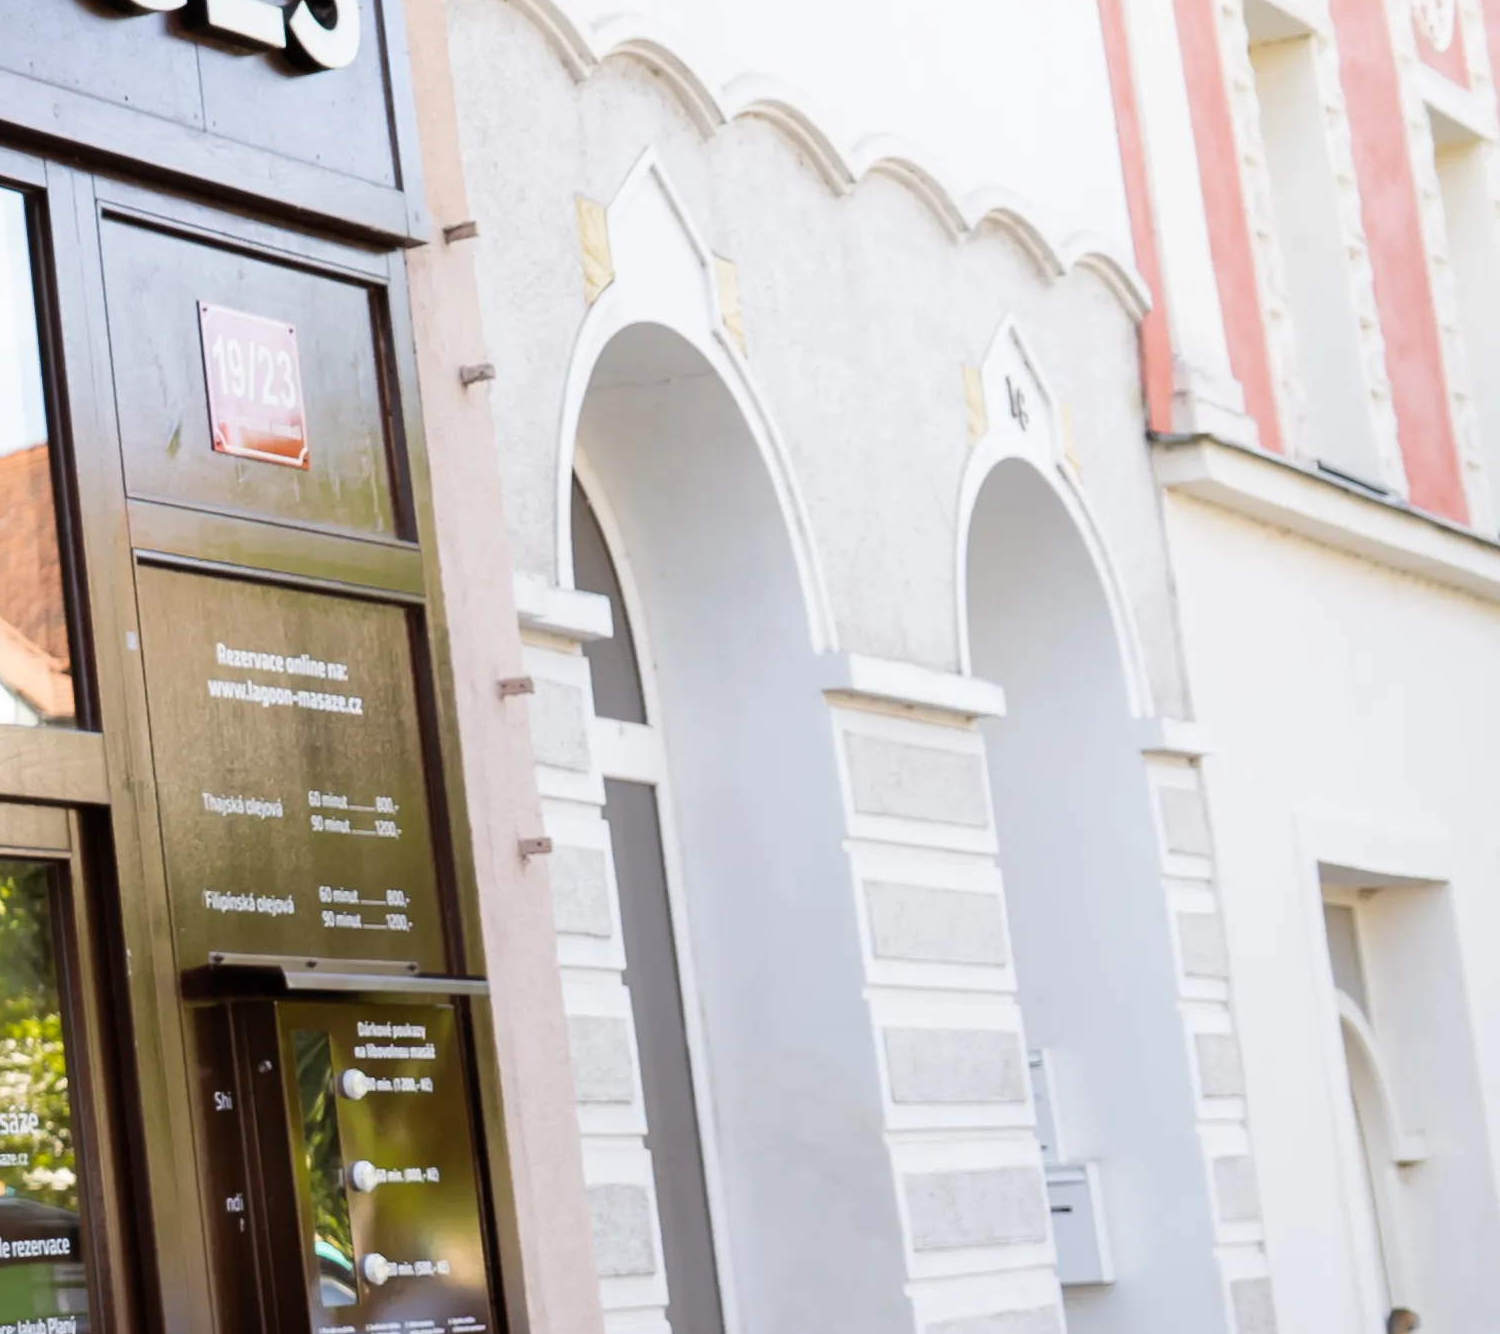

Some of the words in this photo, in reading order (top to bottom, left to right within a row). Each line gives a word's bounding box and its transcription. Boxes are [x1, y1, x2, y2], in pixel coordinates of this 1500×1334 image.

[212, 334, 296, 409] 19/23
[216, 642, 284, 673] Rezervace
[285, 654, 326, 678] online
[328, 662, 348, 681] na:
[207, 679, 363, 715] www.lagoon-masaze.cz
[202, 792, 244, 817] Thajská
[245, 797, 283, 820] olejová
[308, 790, 321, 807] 60
[311, 815, 324, 831] 90
[257, 895, 294, 917] olejová
[318, 885, 332, 903] 60
[321, 910, 335, 927] 90
[12, 1236, 71, 1256] rezervace
